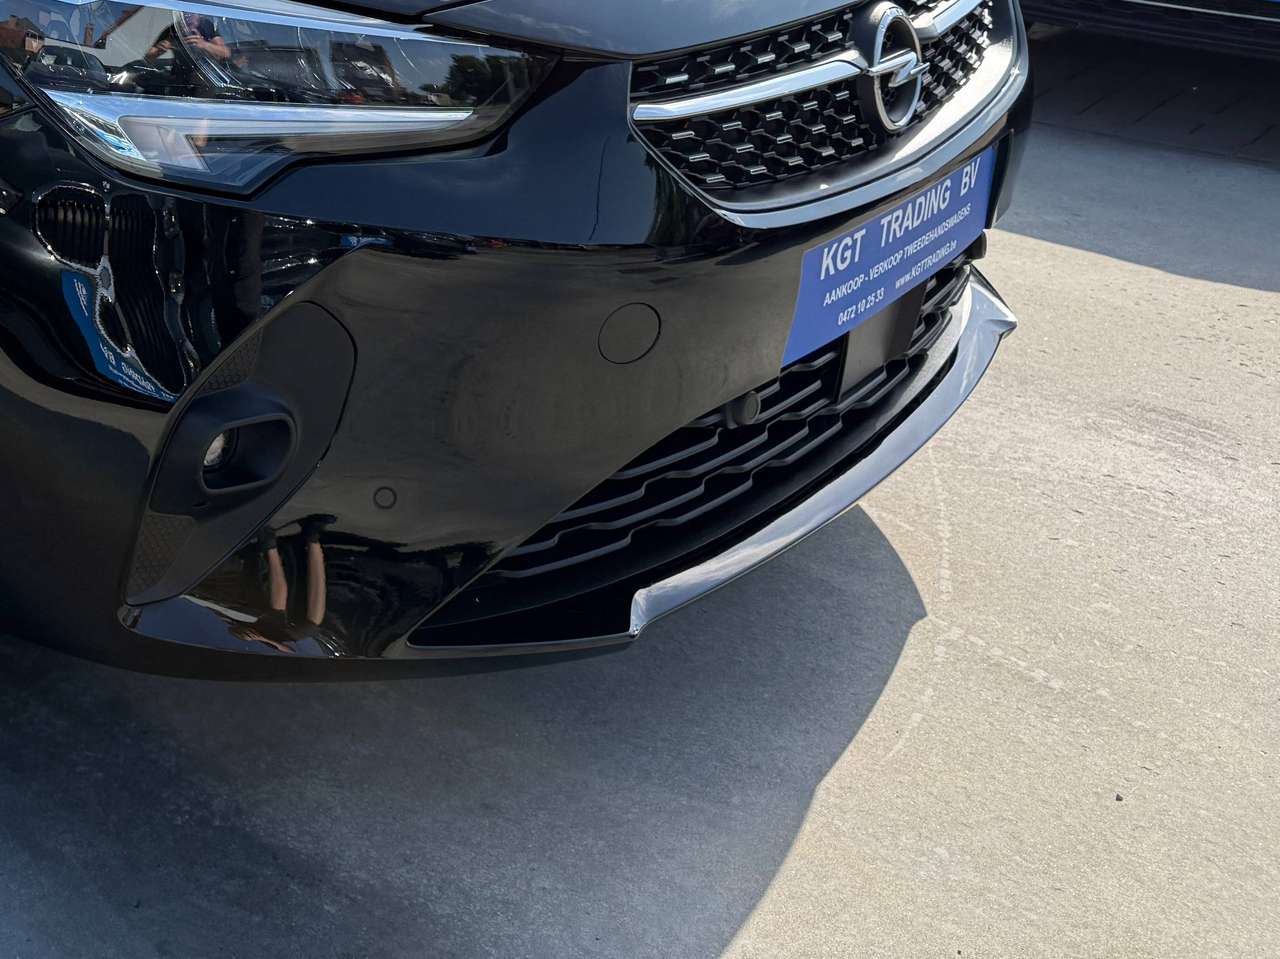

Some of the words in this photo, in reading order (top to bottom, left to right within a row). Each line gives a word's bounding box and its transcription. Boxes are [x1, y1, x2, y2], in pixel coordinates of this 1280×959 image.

[820, 228, 866, 280] KGT
[880, 178, 951, 248] TRADING
[959, 156, 980, 197] BV
[823, 273, 864, 307] AANKOOP
[869, 251, 903, 281] VERKOOP
[837, 304, 856, 326] 0472
[857, 298, 866, 313] 10
[866, 293, 876, 308] 25
[875, 287, 885, 302] 33
